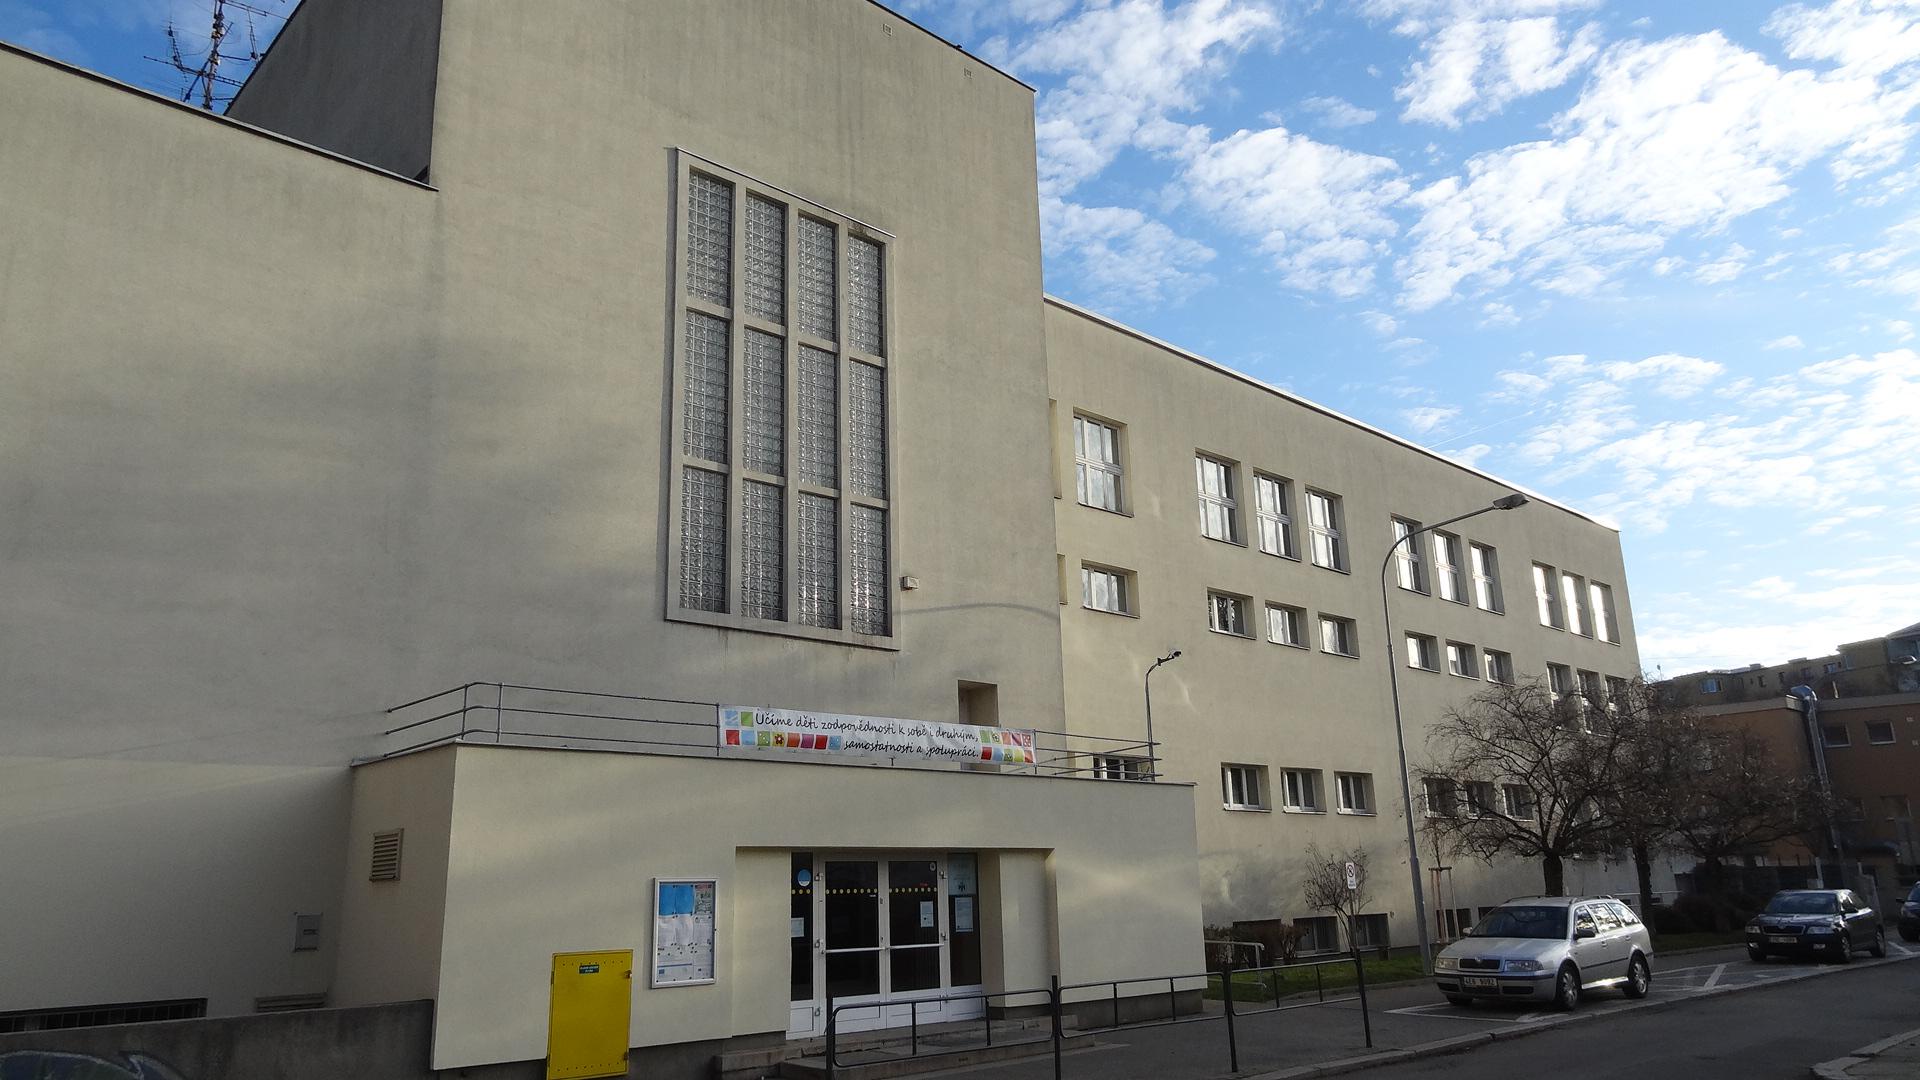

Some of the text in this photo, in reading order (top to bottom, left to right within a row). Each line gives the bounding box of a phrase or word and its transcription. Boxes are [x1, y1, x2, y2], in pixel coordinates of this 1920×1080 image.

[755, 712, 979, 742] Učíme děti zodpovědnosti k sobě i druhým,
[843, 740, 914, 754] samostatnosti
[926, 745, 979, 758] spolupráci.
